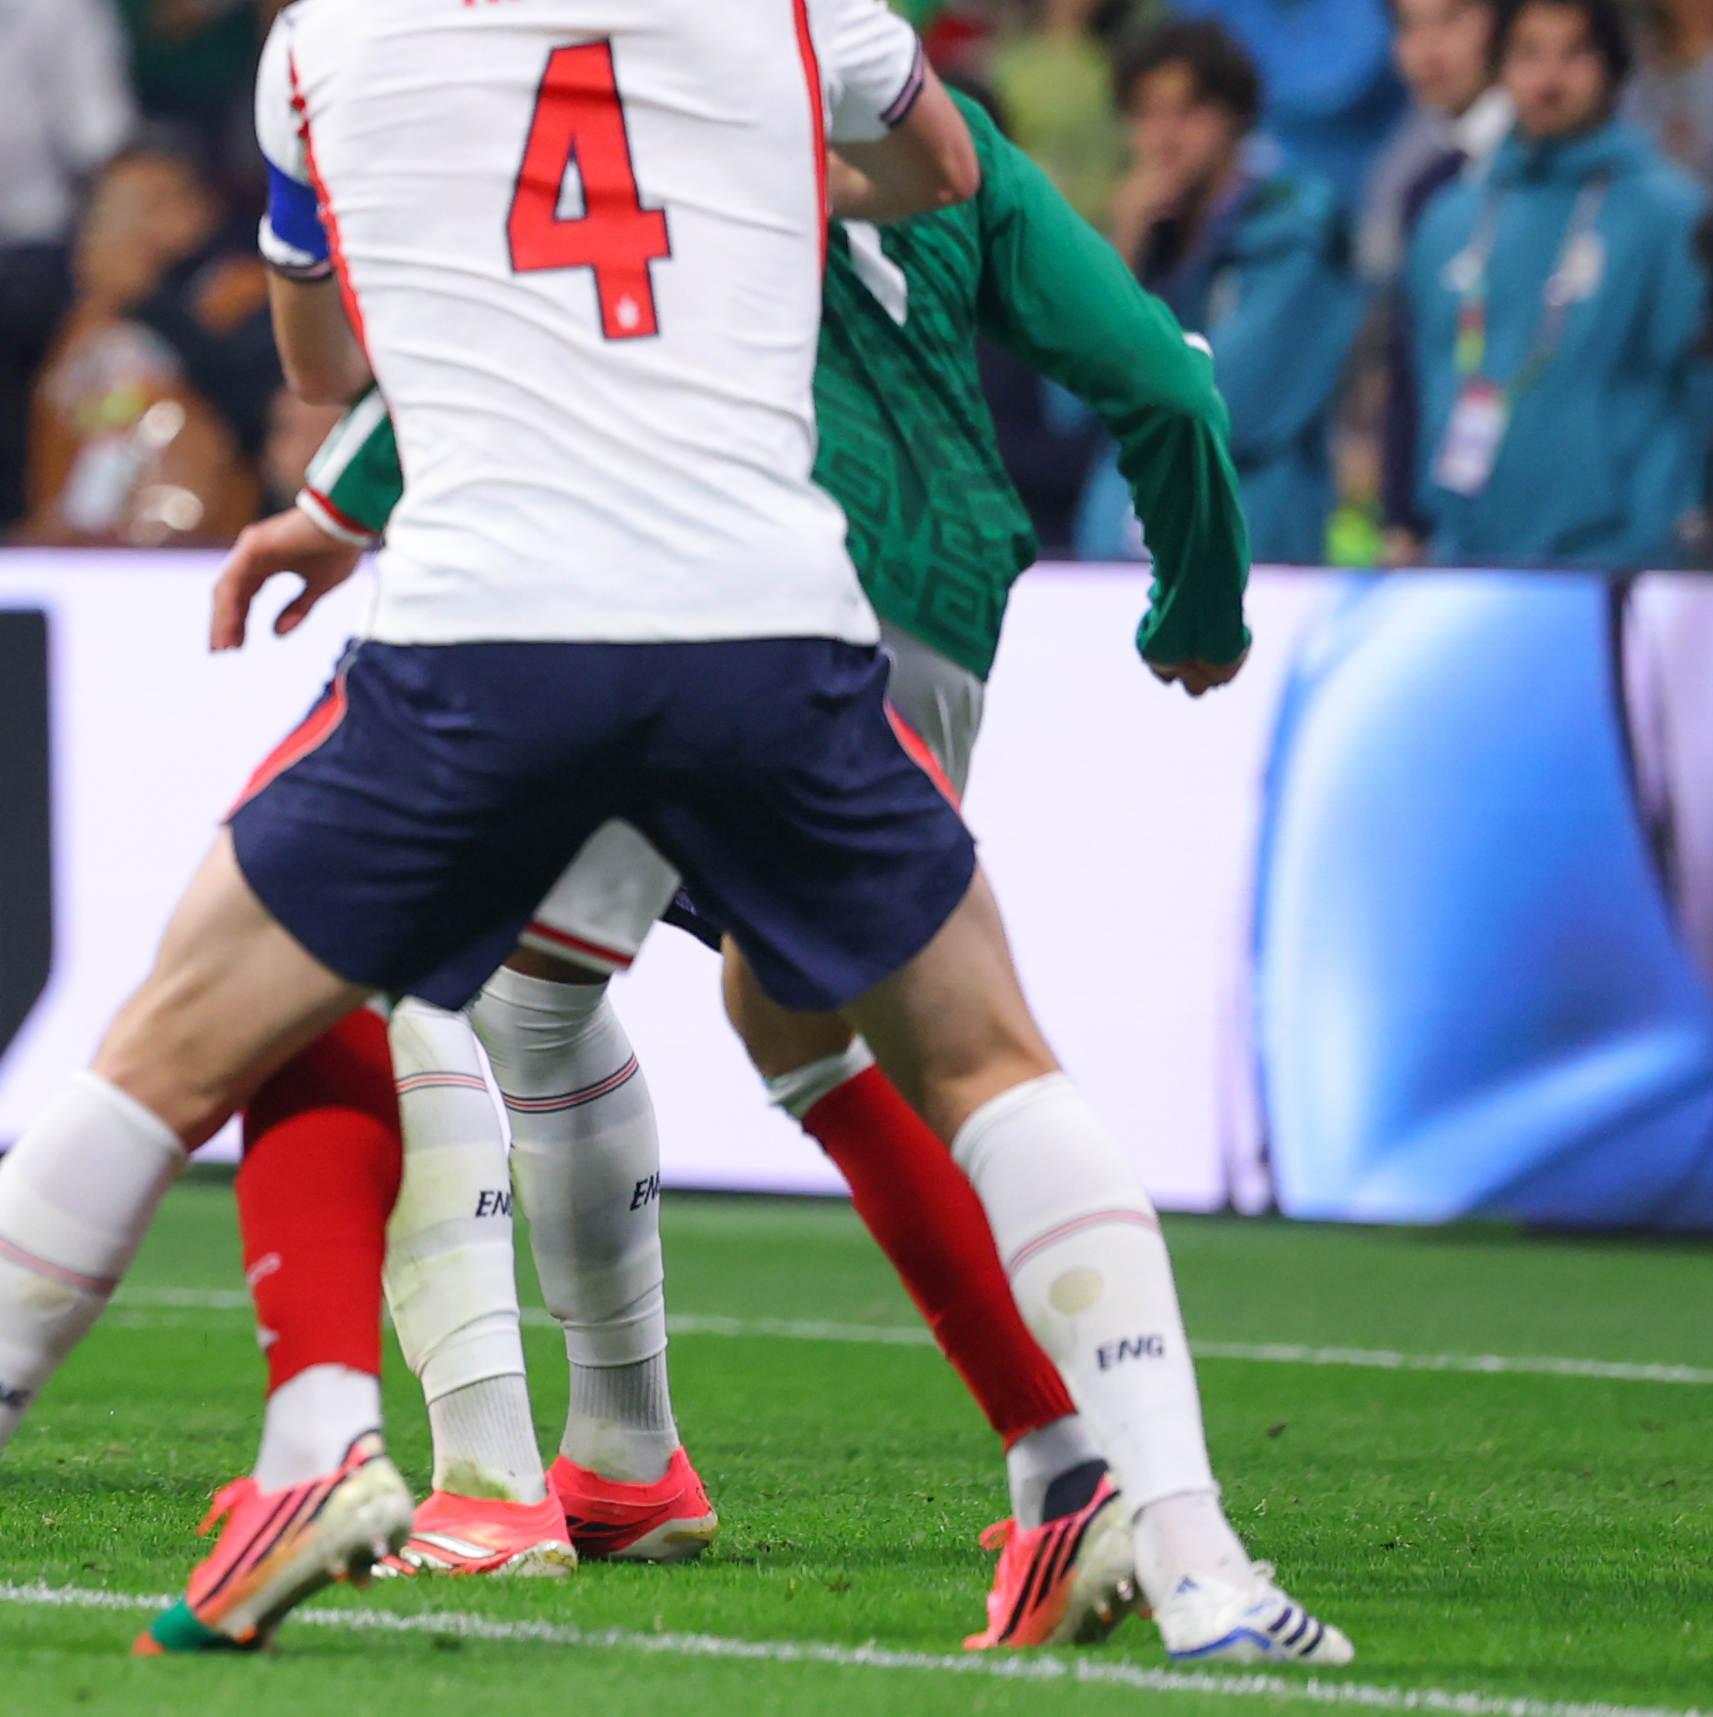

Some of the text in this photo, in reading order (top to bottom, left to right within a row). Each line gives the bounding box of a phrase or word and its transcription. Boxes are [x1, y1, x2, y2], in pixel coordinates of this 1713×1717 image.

[505, 38, 672, 342] 4
[475, 1190, 513, 1218] EN
[629, 1171, 661, 1212] EN
[1097, 1335, 1163, 1372] ENG
